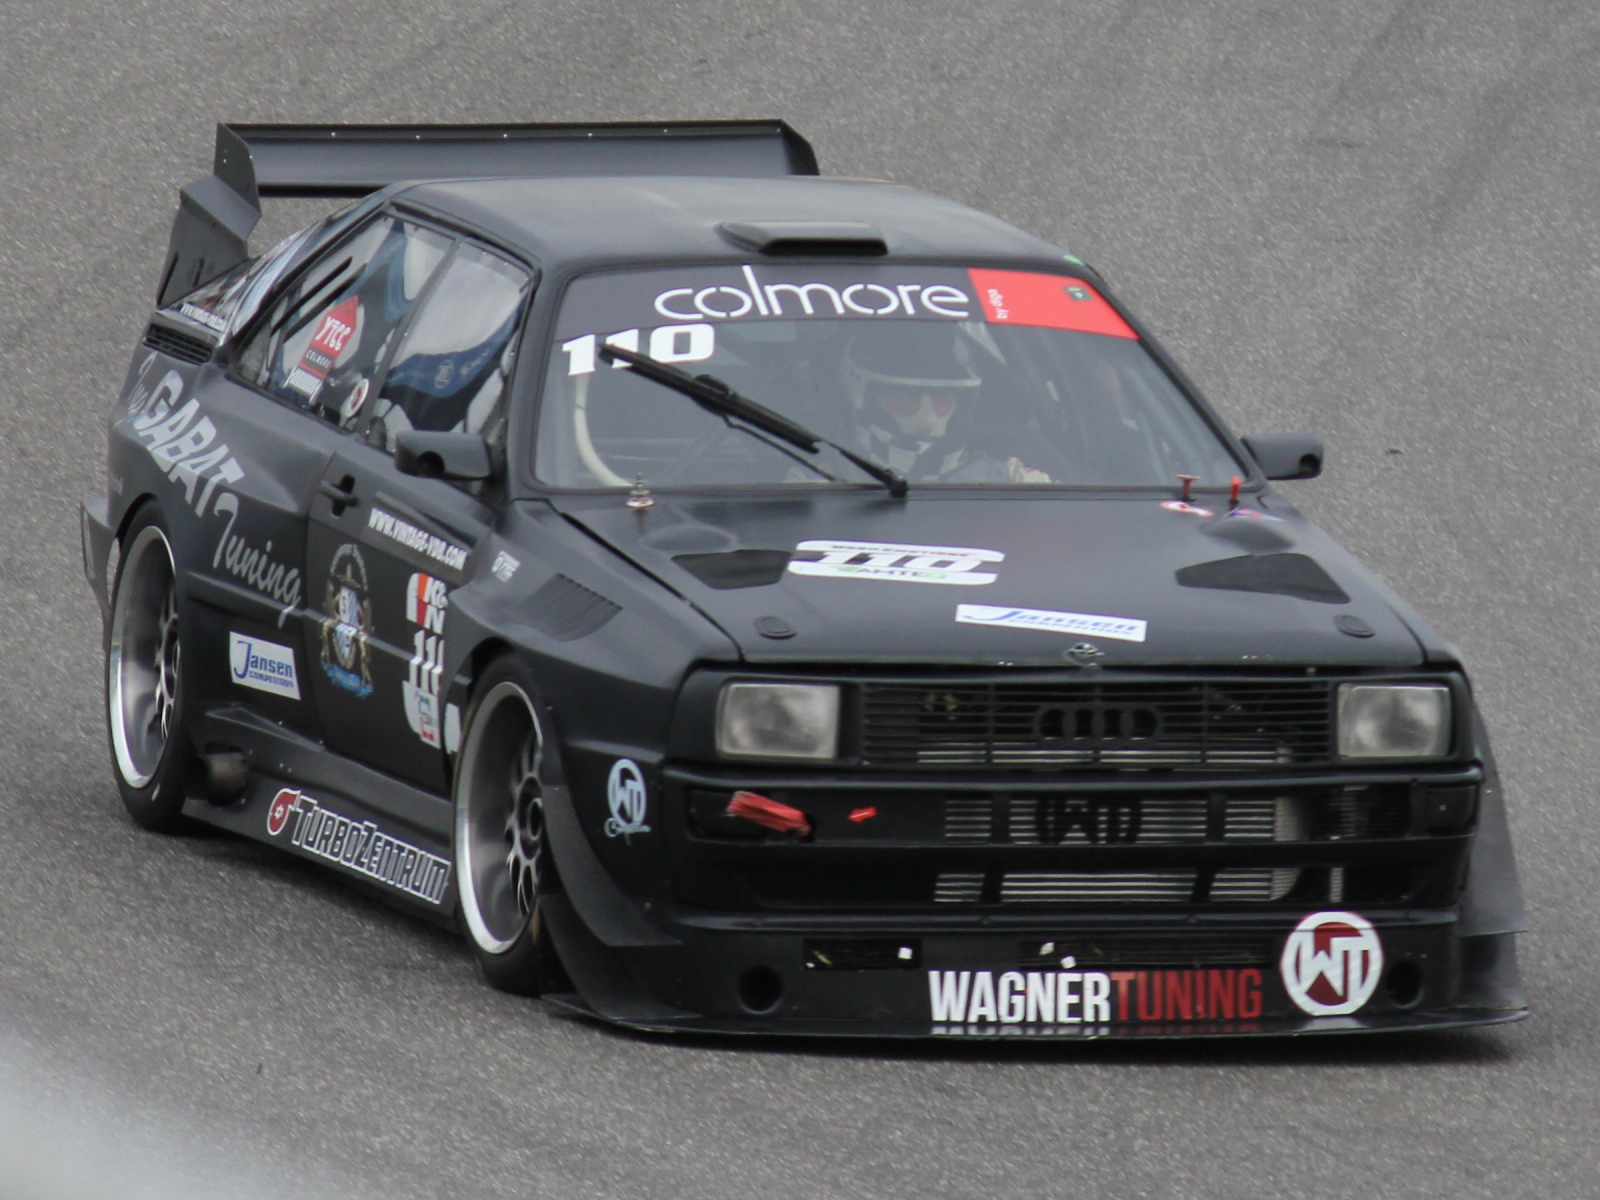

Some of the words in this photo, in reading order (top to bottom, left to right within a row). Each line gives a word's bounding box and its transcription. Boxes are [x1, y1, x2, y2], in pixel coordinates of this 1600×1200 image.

[654, 265, 968, 319] colmore
[133, 369, 245, 518] GABAT
[213, 491, 302, 629] Tuning
[233, 640, 294, 679] Jansen
